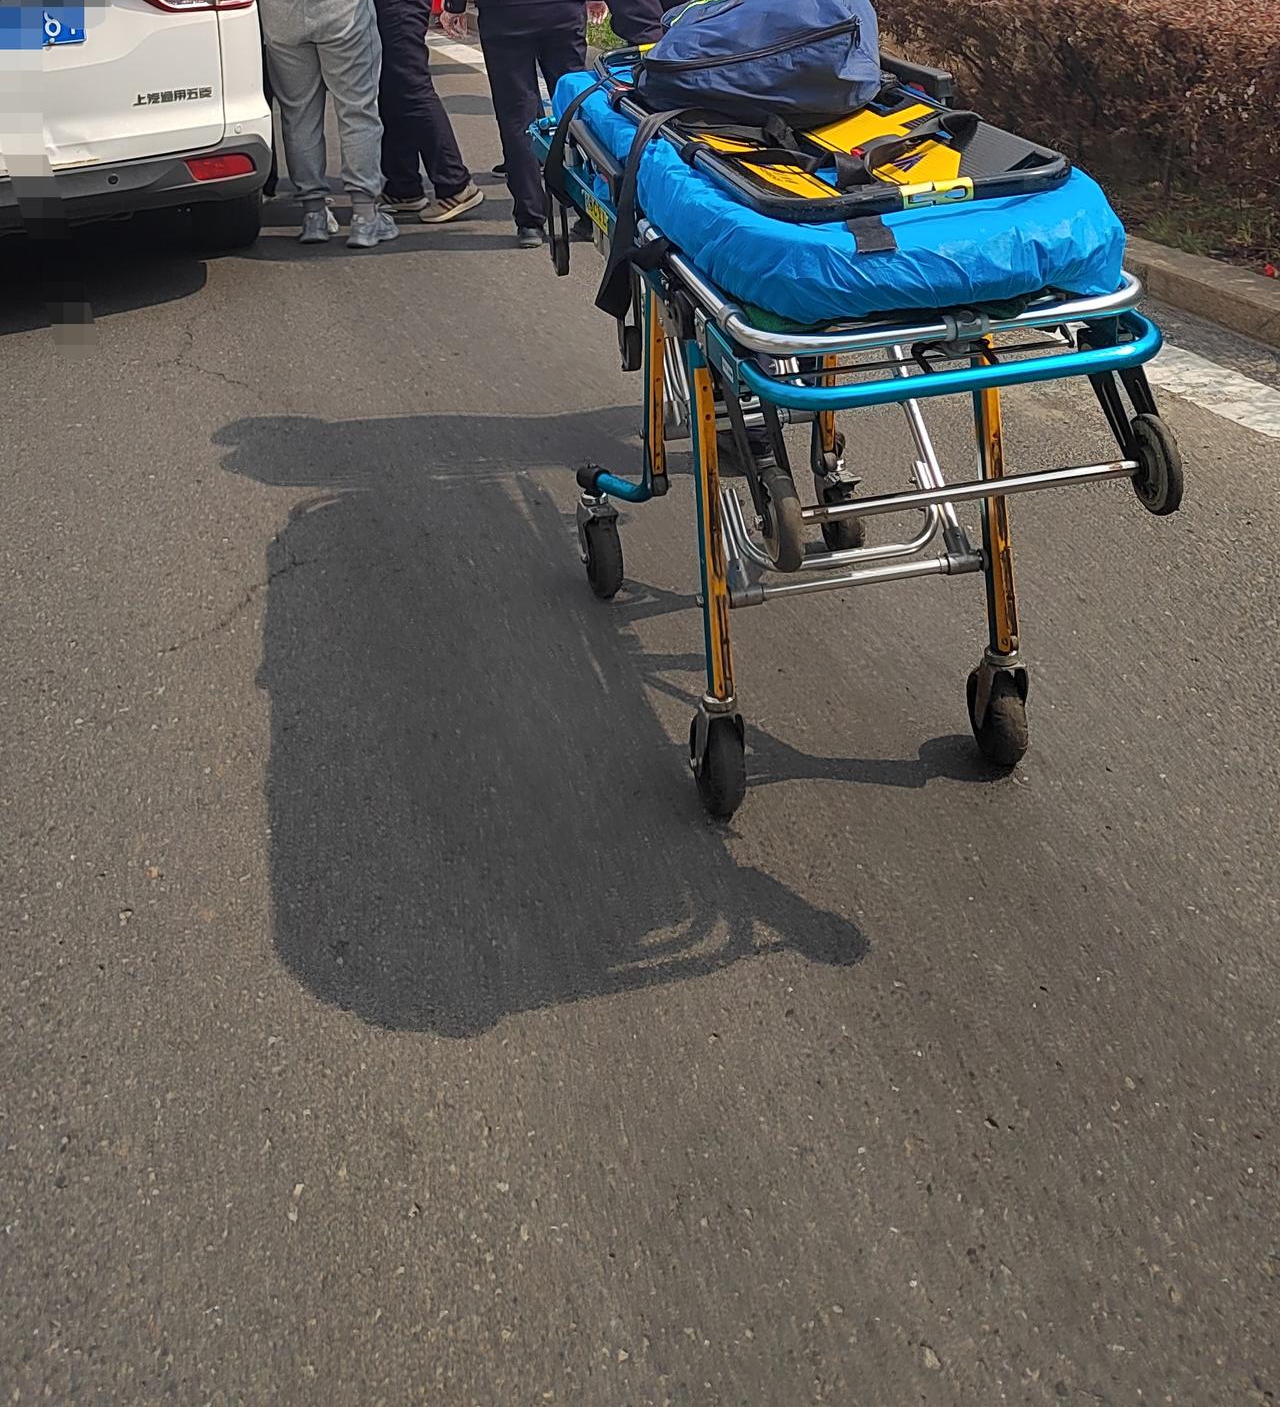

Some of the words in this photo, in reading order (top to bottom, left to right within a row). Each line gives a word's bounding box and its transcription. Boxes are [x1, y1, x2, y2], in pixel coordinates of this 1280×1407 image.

[132, 86, 212, 107] 上汽通用五菱
